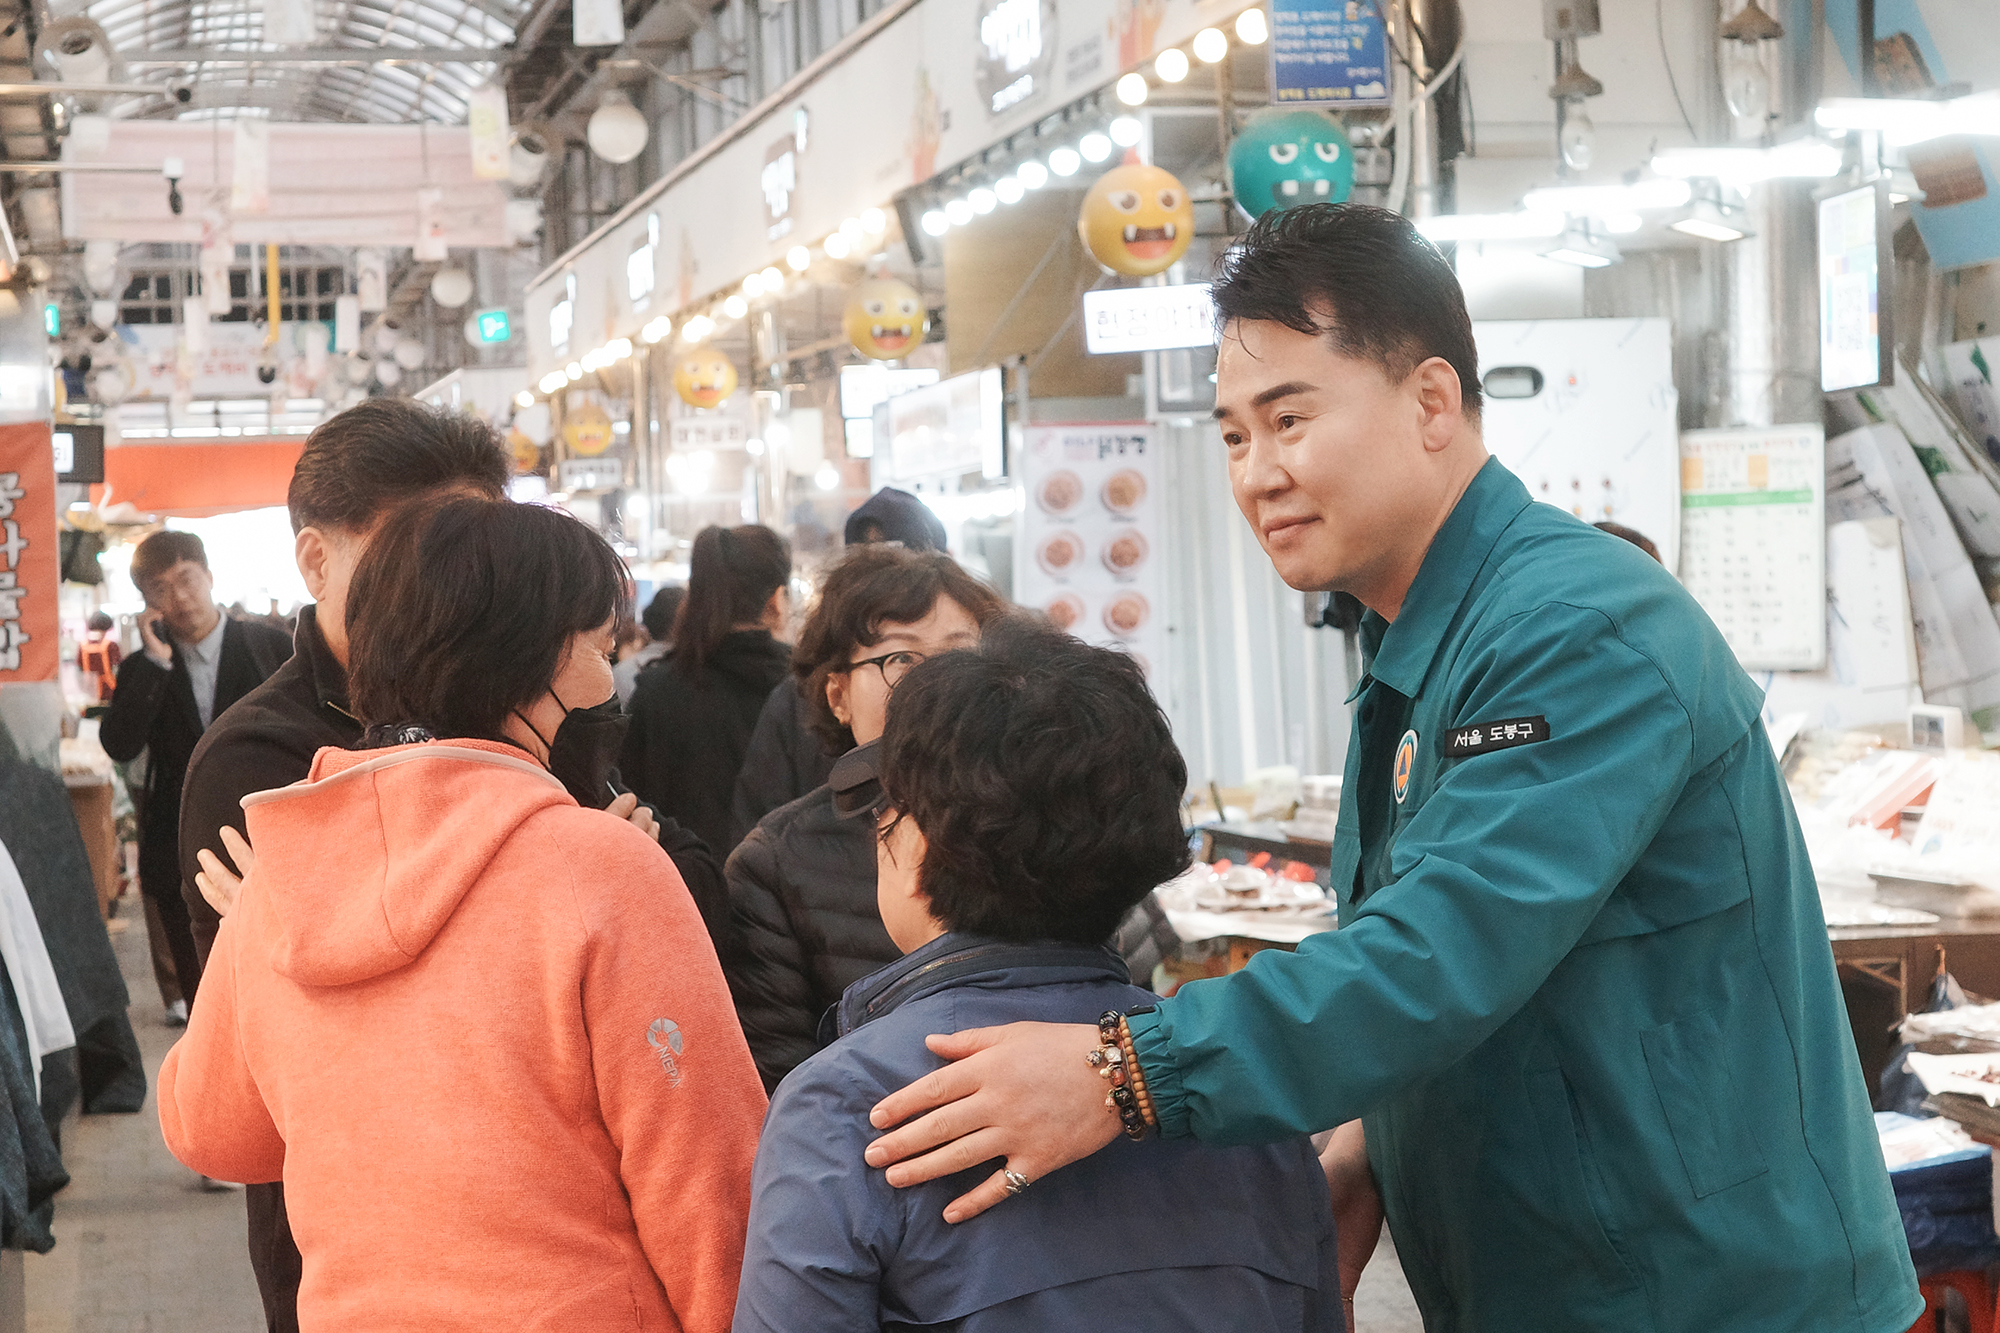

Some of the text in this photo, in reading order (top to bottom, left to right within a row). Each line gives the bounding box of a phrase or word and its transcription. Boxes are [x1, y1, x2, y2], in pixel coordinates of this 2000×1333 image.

[1453, 722, 1534, 748] 서울 도봉구
[656, 1045, 681, 1089] NEPA
